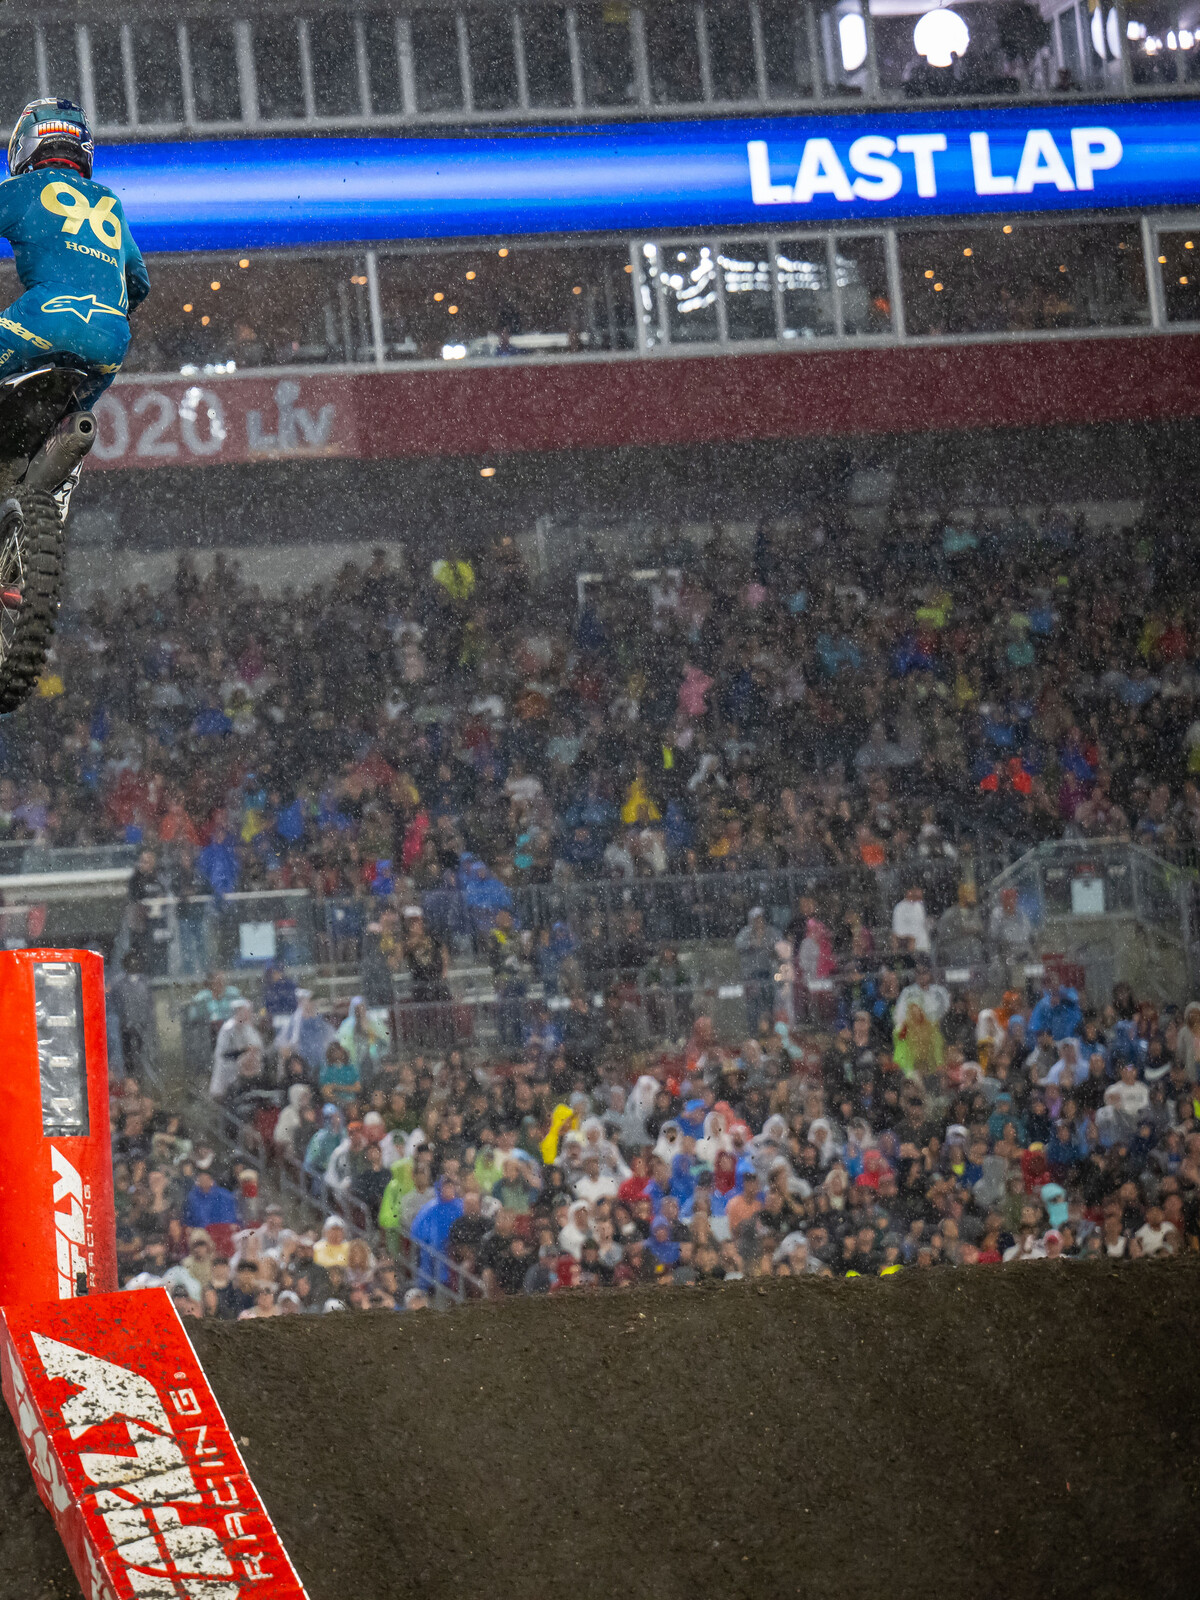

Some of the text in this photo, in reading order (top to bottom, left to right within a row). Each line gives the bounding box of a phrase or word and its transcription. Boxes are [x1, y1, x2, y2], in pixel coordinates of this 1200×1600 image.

[747, 126, 1123, 205] LAST LAP
[40, 181, 122, 250] 96
[64, 240, 119, 268] HONDA
[90, 386, 227, 460] 020
[51, 1145, 90, 1300] FLY
[82, 1184, 97, 1288] RACING
[30, 1331, 241, 1600] FLY
[169, 1388, 274, 1581] RACING
